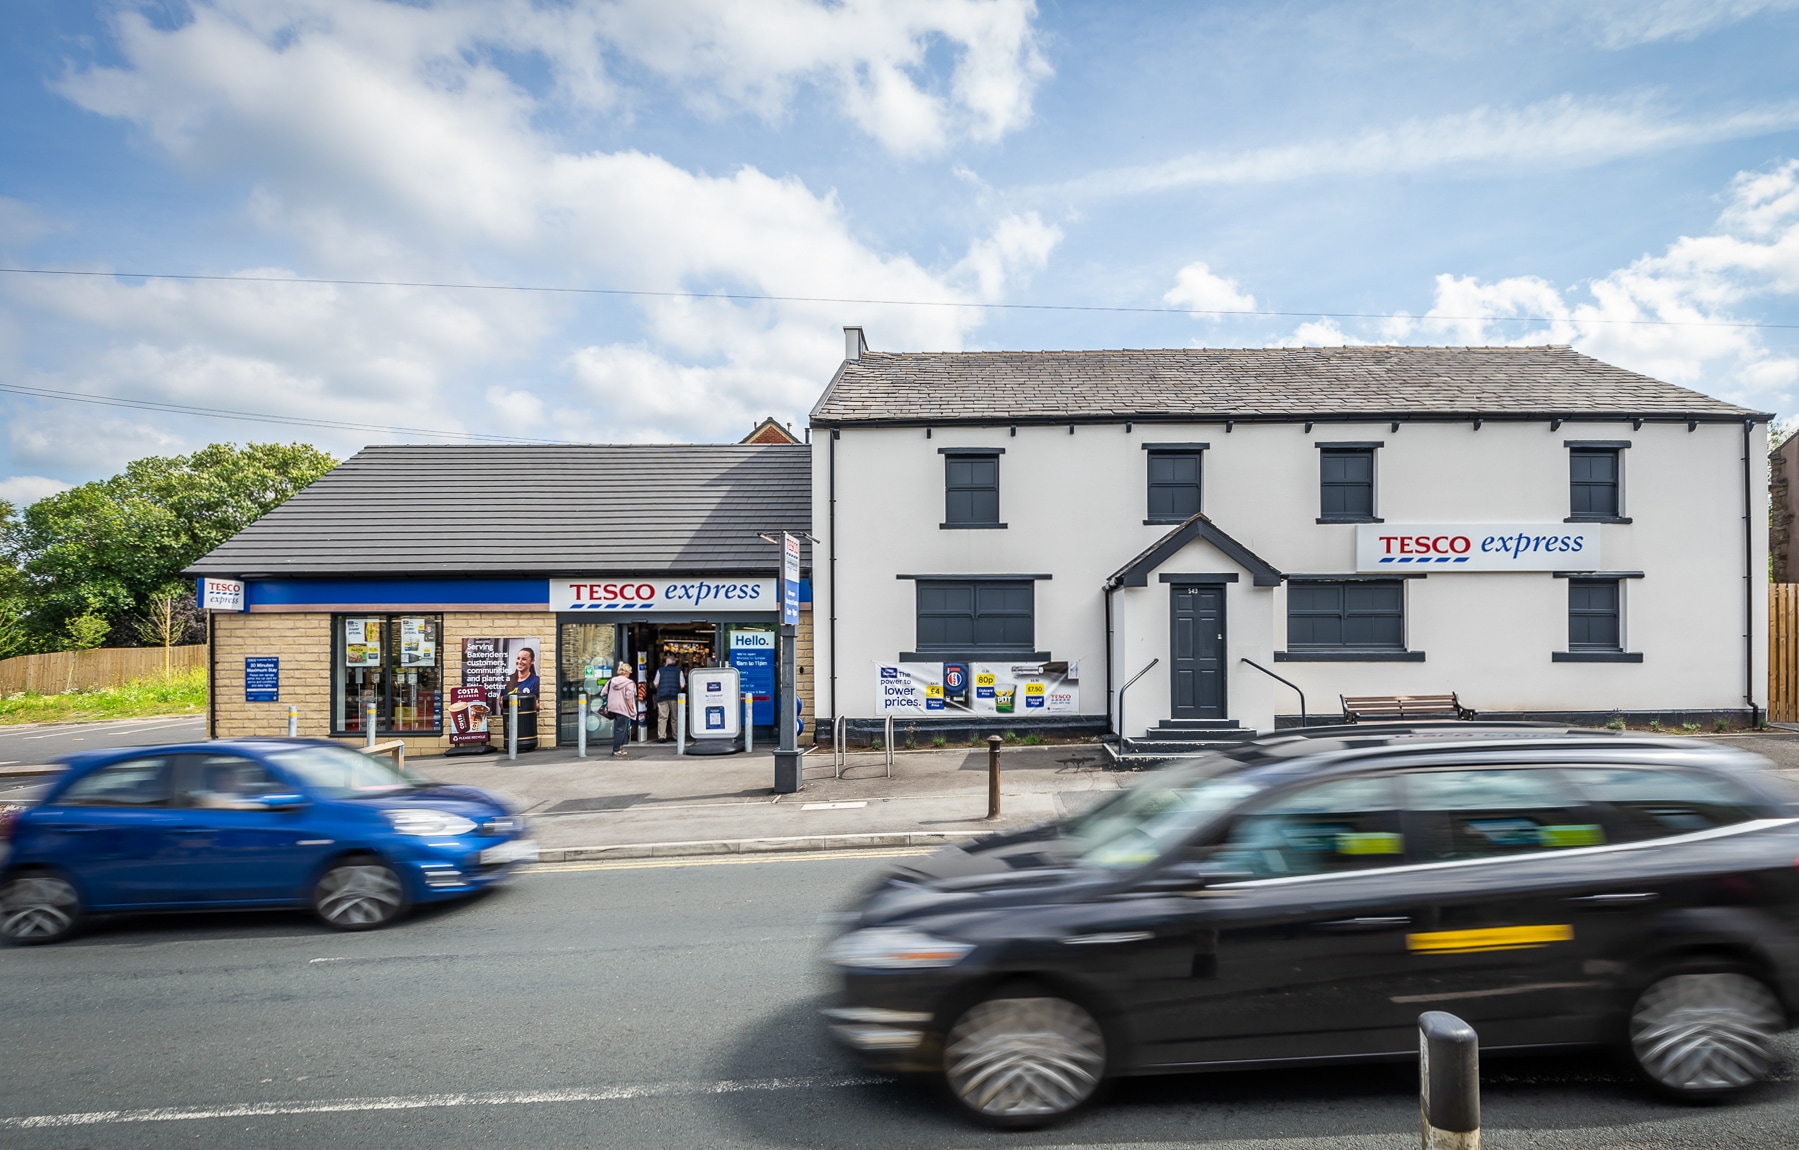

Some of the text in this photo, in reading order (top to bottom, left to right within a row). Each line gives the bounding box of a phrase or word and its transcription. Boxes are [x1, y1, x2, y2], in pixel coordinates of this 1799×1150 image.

[1379, 532, 1584, 559] TESCO express
[209, 582, 240, 592] TESCO
[569, 583, 656, 601] TESCO
[664, 581, 761, 606] express
[210, 596, 239, 605] express
[735, 635, 769, 646] Hello.
[467, 643, 494, 651] Serving
[482, 675, 504, 683] planet
[978, 676, 993, 685] 80p
[487, 691, 501, 699] day
[884, 685, 916, 696] lower
[884, 697, 922, 709] prices.
[457, 713, 465, 730] COSTA
